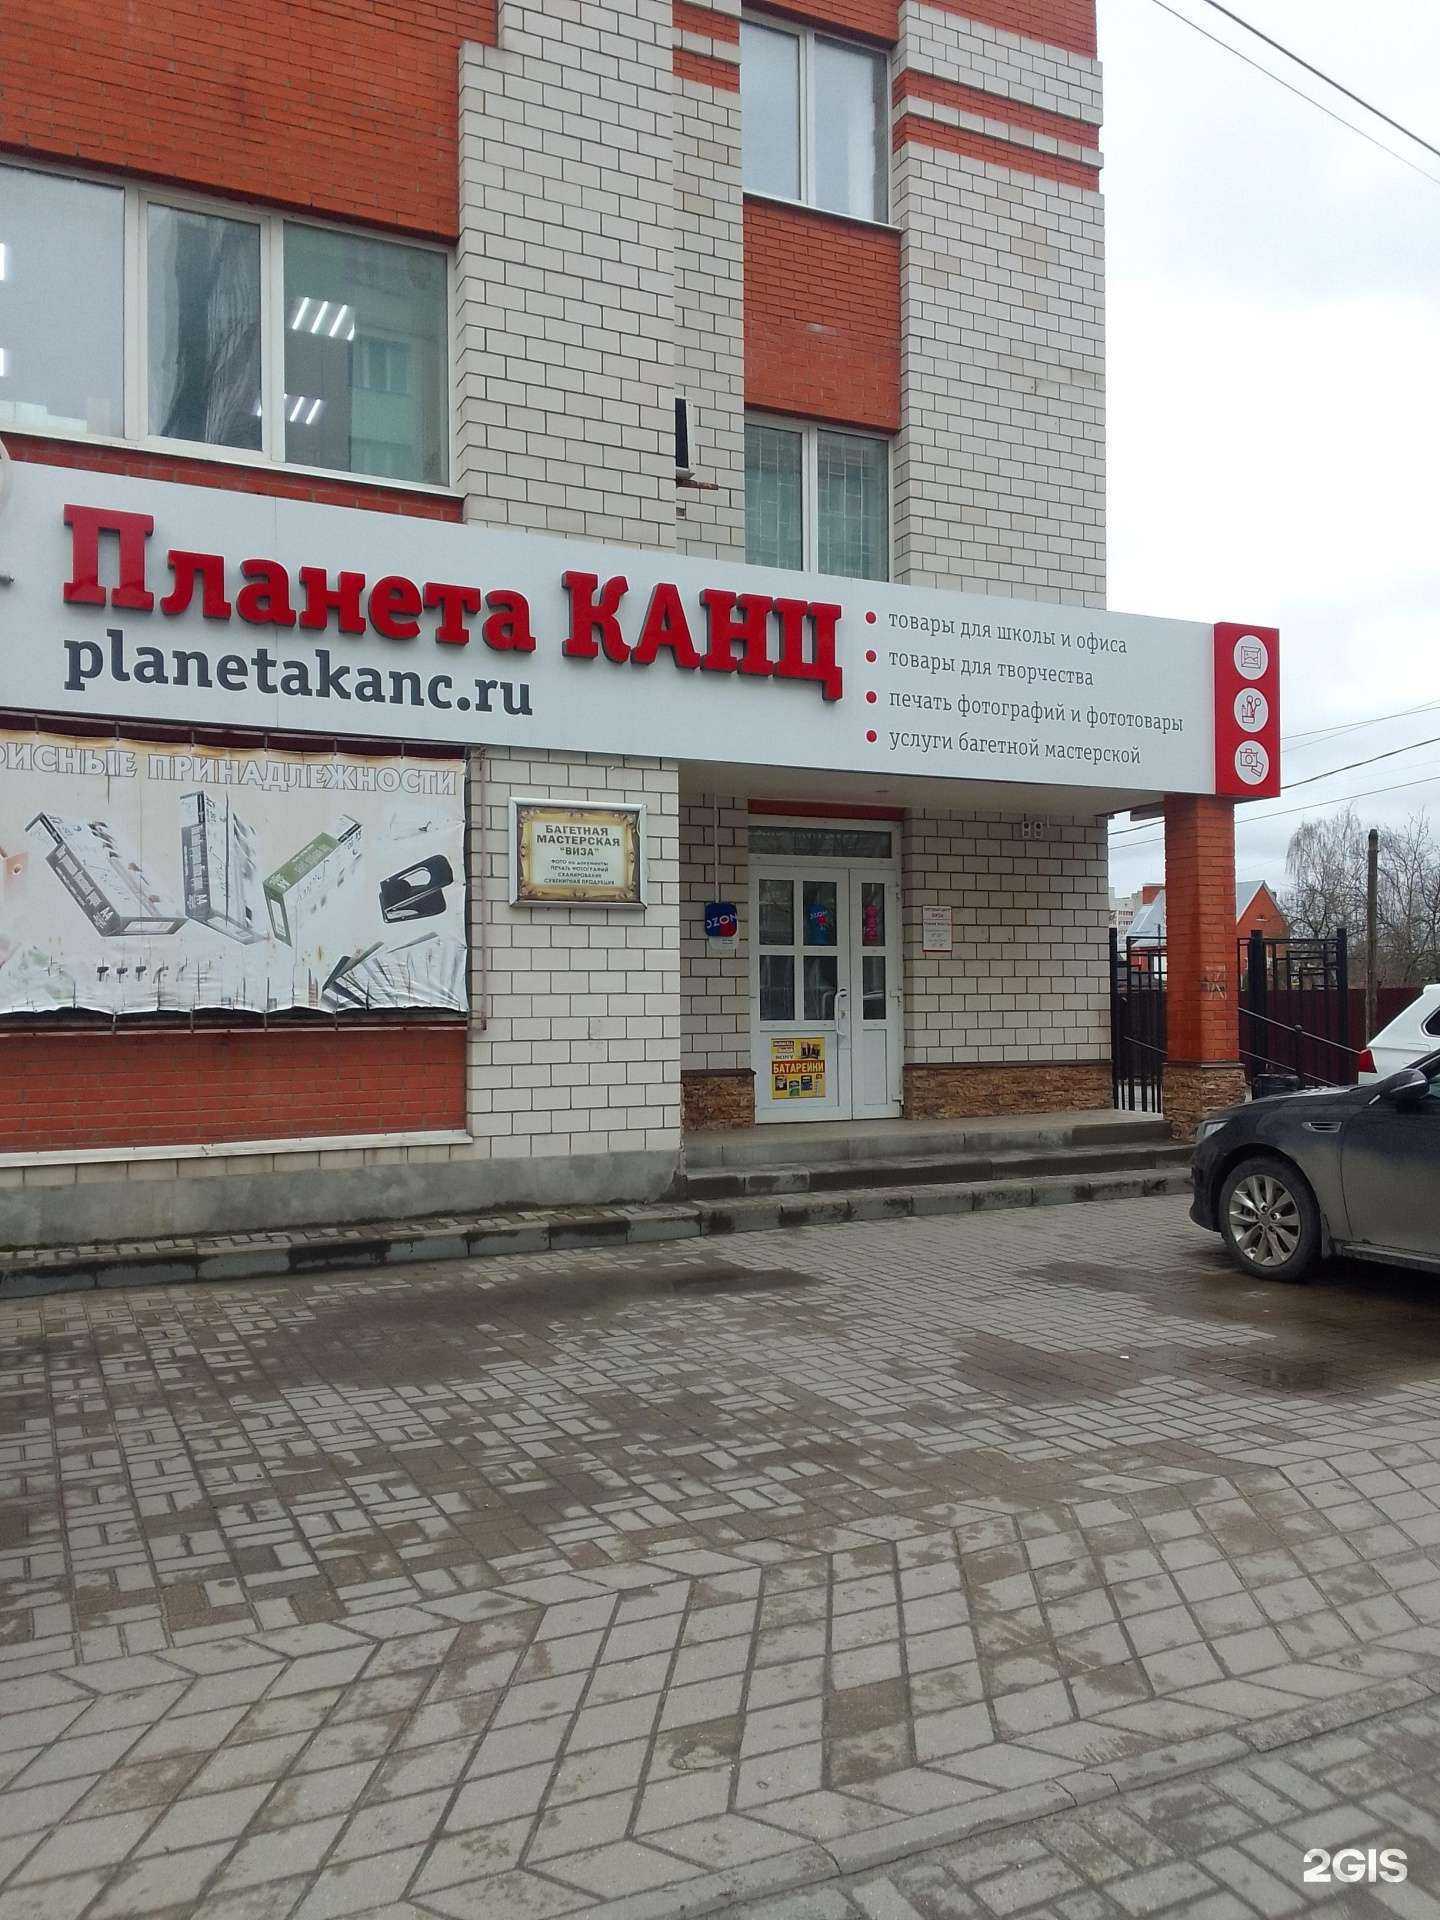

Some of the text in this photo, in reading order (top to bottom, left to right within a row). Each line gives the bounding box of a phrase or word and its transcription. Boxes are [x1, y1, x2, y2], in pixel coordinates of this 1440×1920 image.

[63, 503, 843, 702] Планета КАНЦ
[888, 611, 1128, 656] товары для школы и офиса
[63, 628, 533, 716] planetakanc.ru
[888, 650, 1094, 687] товары для творчества
[889, 690, 1184, 733] печать фотографий и фототовары
[889, 730, 1141, 765] услуги багетной мастерской
[147, 753, 457, 795] ПРИНАДЛЕЖНОСТИ
[536, 834, 620, 846] МАСТЕРСКАЯ
[545, 824, 608, 836] БАГЕТНАЯ
[773, 1061, 824, 1074] БАТАРЕЙКИ
